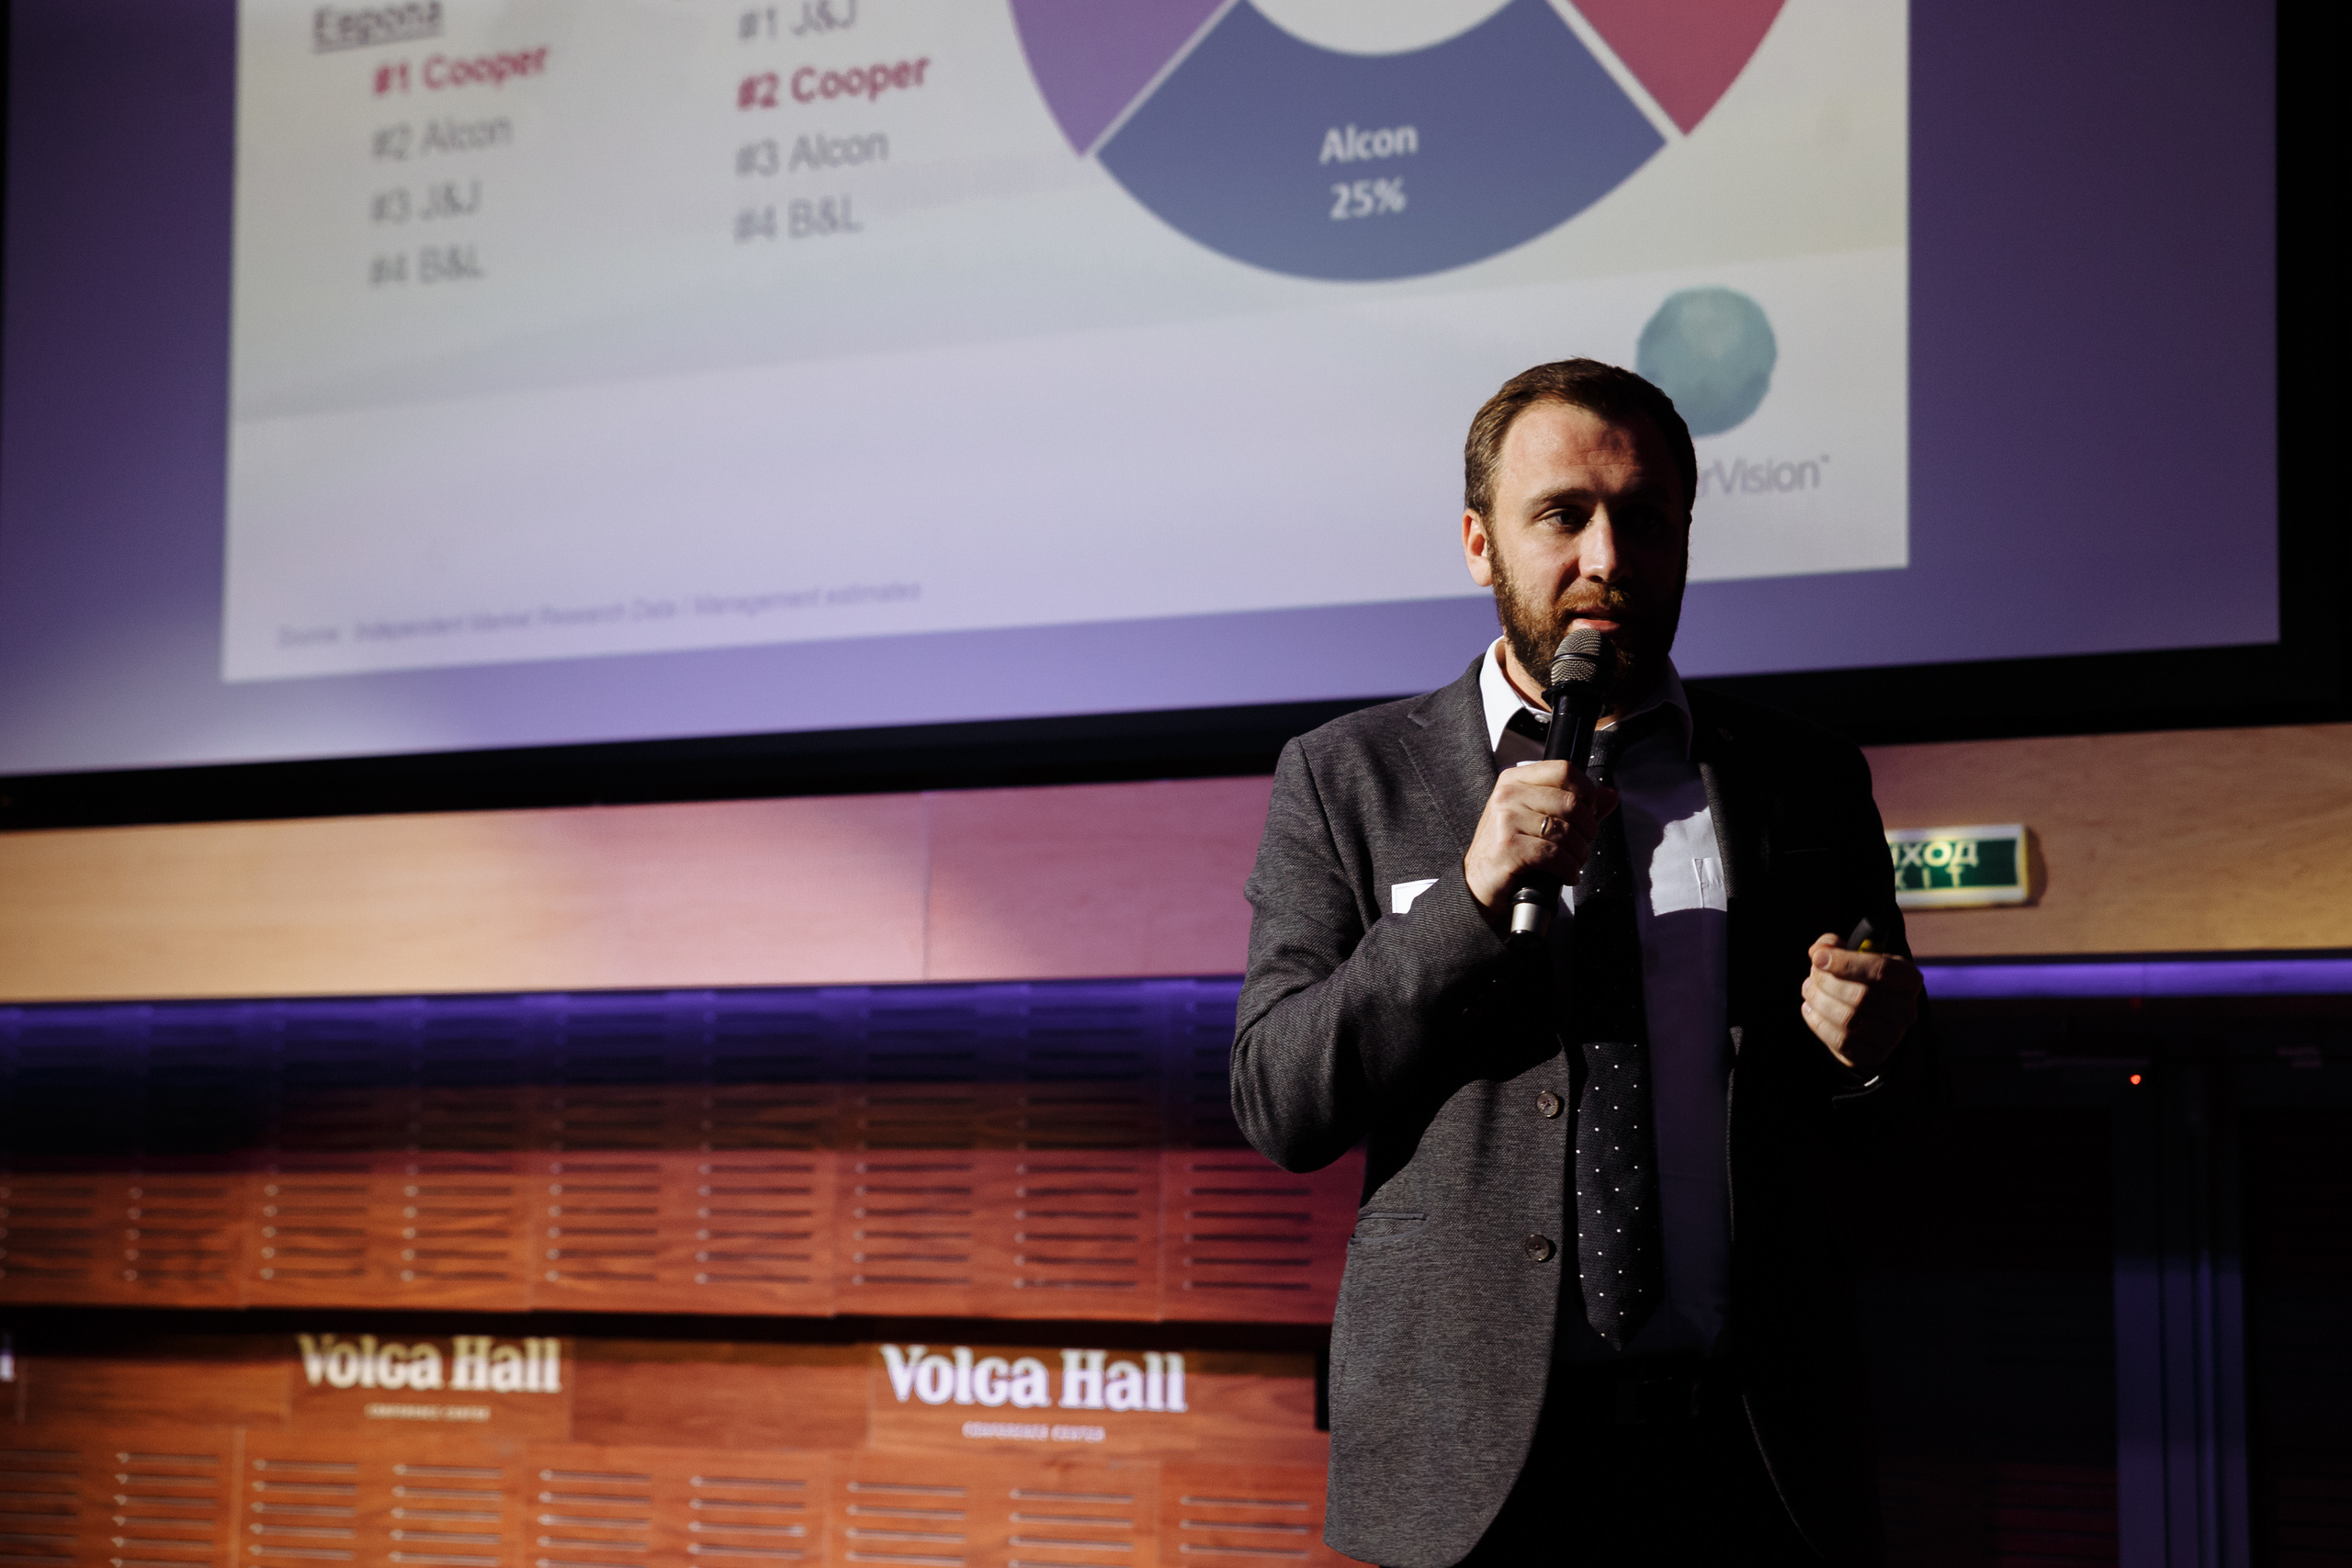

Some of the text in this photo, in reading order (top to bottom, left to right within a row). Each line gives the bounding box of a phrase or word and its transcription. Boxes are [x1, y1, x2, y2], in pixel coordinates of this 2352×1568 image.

[737, 0, 857, 39] #1 J&J
[372, 46, 549, 96] #1 Cooper
[737, 57, 930, 110] #2 Cooper
[371, 116, 512, 159] #2 Alcon
[735, 131, 888, 176] #3 Alcon
[1319, 122, 1419, 165] Alcon
[370, 179, 482, 224] #3 J&J
[734, 193, 865, 243] #4 B&L
[1329, 175, 1408, 221] 25%
[370, 244, 486, 288] #4 B&L
[449, 1335, 562, 1393] Hall
[1057, 1348, 1190, 1413] Hall
